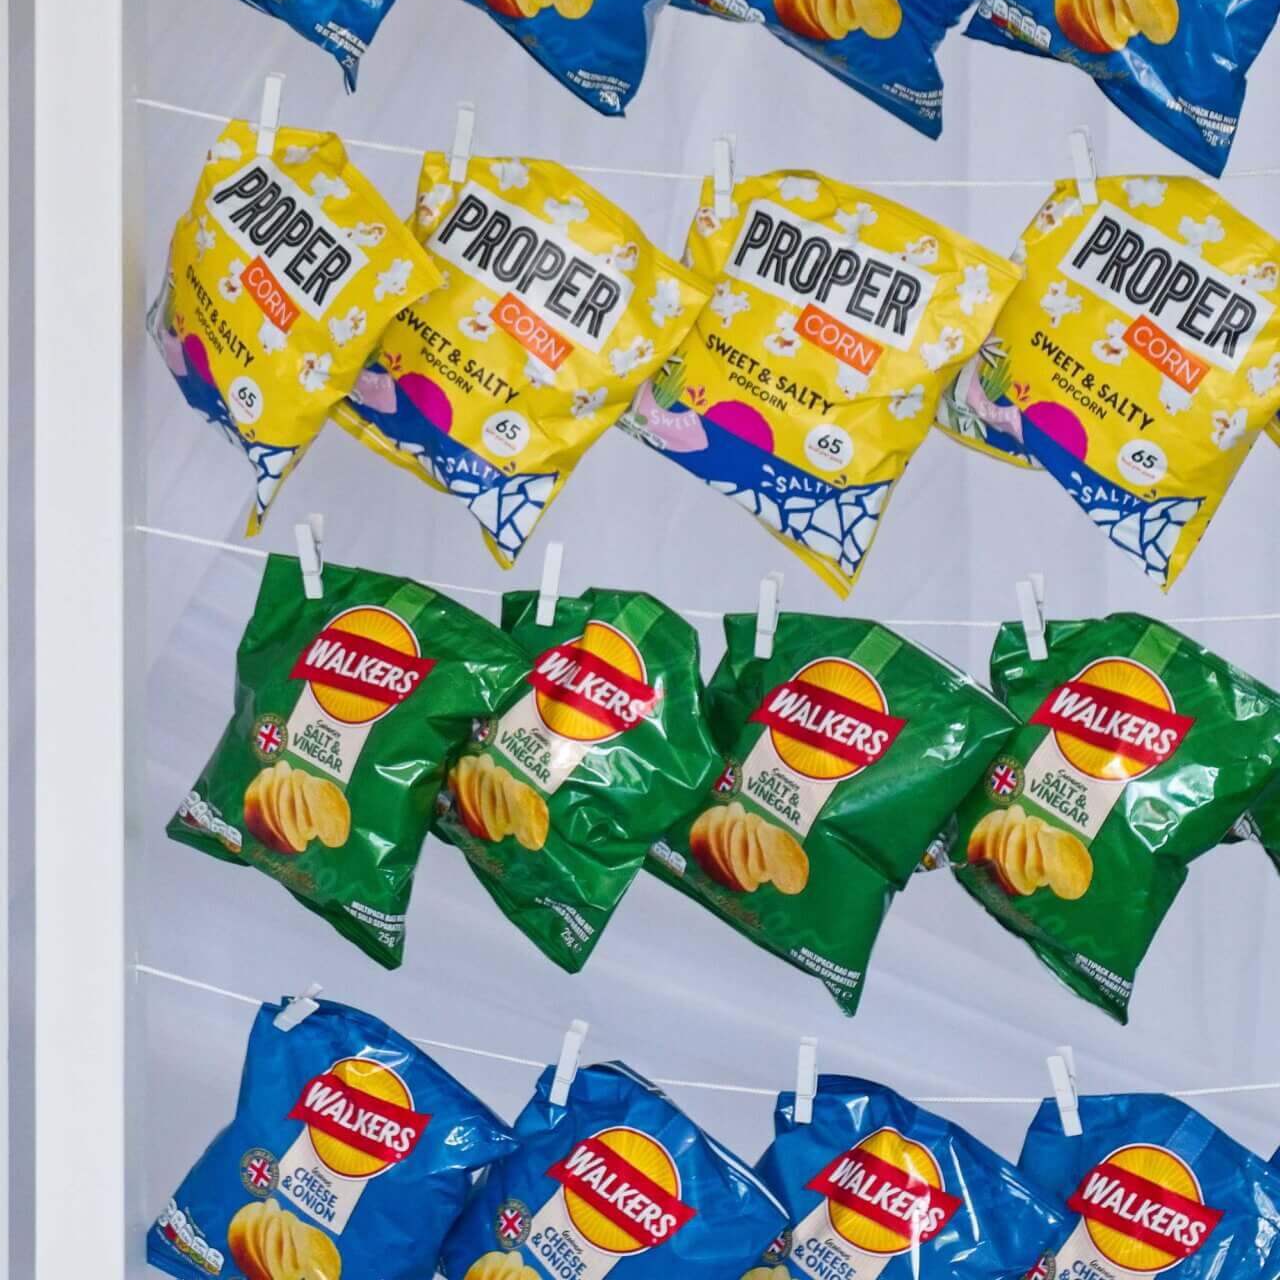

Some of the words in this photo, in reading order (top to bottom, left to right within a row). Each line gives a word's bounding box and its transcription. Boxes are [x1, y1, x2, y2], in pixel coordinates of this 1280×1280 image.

[213, 166, 352, 307] PROPER
[438, 193, 621, 339] PROPER
[733, 210, 921, 337] PROPER
[1071, 215, 1257, 359] PROPER
[186, 265, 213, 314] SWEET
[208, 310, 219, 323] &
[218, 320, 256, 368] SALTY
[247, 267, 293, 327] CORN
[194, 307, 225, 355] POPCORN
[396, 308, 451, 353] SWEET
[452, 349, 464, 367] &
[464, 355, 519, 404] SALTY
[500, 303, 566, 362] CORN
[804, 314, 875, 367] CORN
[1133, 326, 1201, 385] CORN
[238, 386, 256, 408] 65
[420, 348, 473, 394] POPCORN
[706, 333, 759, 376] SWEET
[759, 369, 771, 385] &
[776, 375, 835, 416] SALTY
[728, 371, 788, 412] POPCORN
[1031, 331, 1085, 379] SWEET
[1081, 373, 1096, 389] &
[1098, 384, 1155, 432] SALTY
[1051, 373, 1108, 420] POPCORN
[495, 419, 521, 441] 65
[817, 434, 842, 455] 65
[1131, 449, 1158, 470] 65
[304, 638, 419, 694] WALKERS
[537, 652, 645, 723] WALKERS
[304, 724, 333, 748] SALT
[330, 741, 341, 756] &
[514, 727, 543, 758] SALT
[539, 750, 552, 764] &
[768, 688, 889, 756] WALKERS
[1049, 687, 1178, 756] WALKERS
[292, 732, 343, 773] VINEGAR
[499, 731, 552, 784] VINEGAR
[746, 776, 801, 826] VINEGAR
[758, 771, 788, 799] SALT
[789, 792, 800, 808] &
[1030, 778, 1090, 827] VINEGAR
[1042, 772, 1077, 799] SALT
[1075, 794, 1087, 810] &
[304, 1081, 416, 1152] WALKERS
[281, 1175, 293, 1191] &
[292, 1184, 336, 1222] ONION
[294, 1167, 338, 1208] CHEESE
[564, 1144, 678, 1238] WALKERS
[828, 1157, 945, 1234] WALKERS
[1082, 1172, 1207, 1247] WALKERS
[532, 1233, 542, 1247] &
[544, 1226, 587, 1275] CHEESE
[794, 1245, 805, 1260] &
